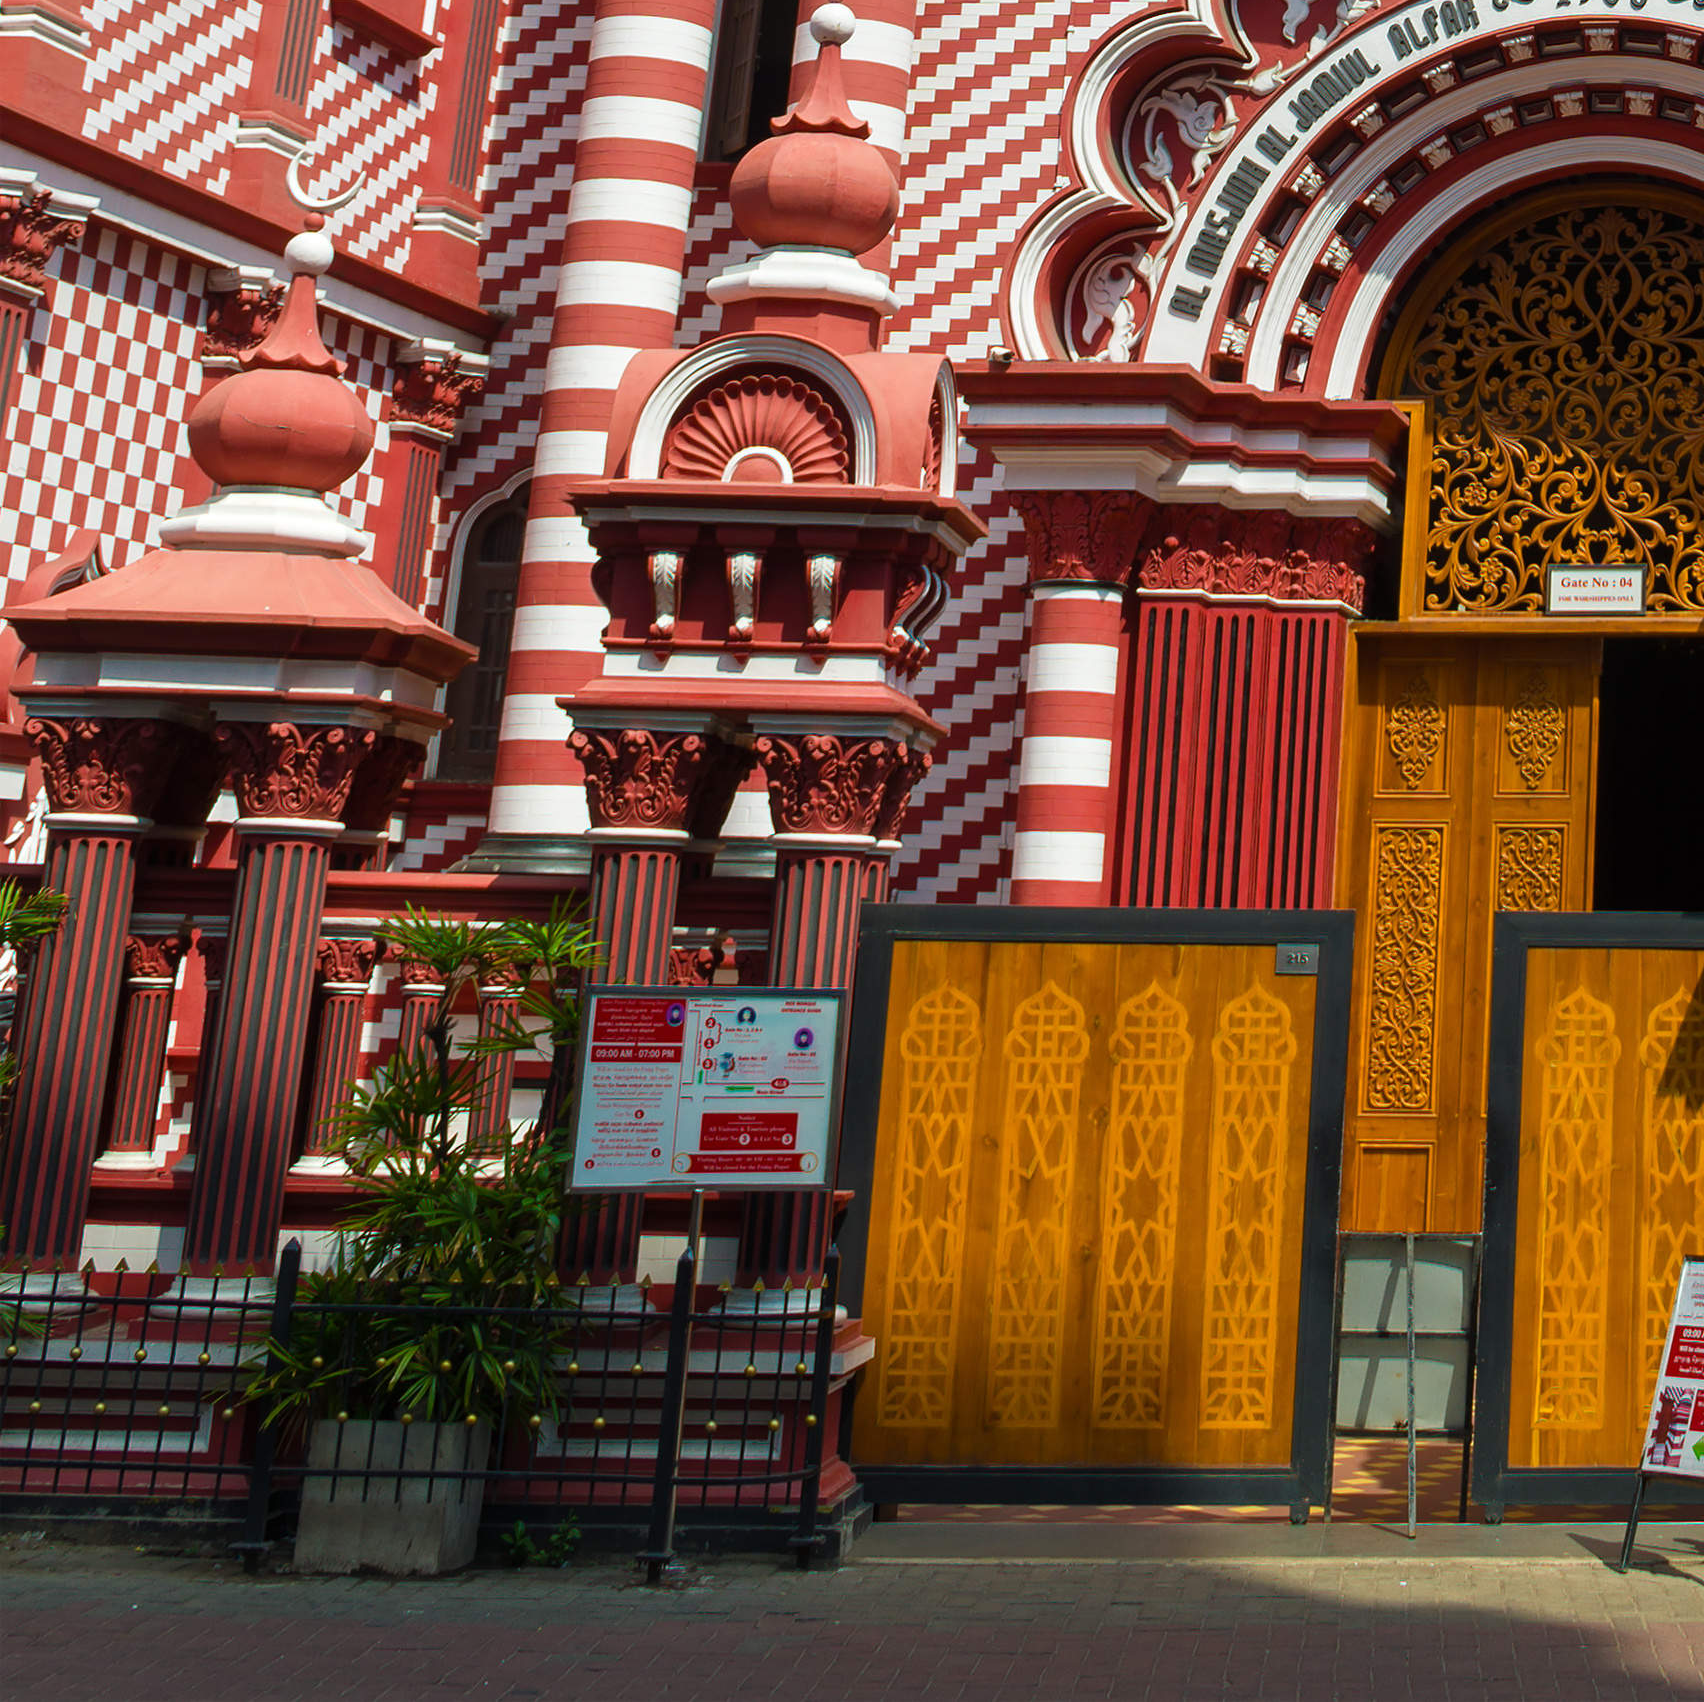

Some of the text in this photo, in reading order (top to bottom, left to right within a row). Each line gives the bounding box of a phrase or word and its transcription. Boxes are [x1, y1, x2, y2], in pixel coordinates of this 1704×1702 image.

[1295, 48, 1382, 134] JAMIUL
[1255, 123, 1298, 167] AL
[1185, 157, 1271, 280] MASJIDH
[1167, 284, 1211, 323] AL
[1561, 576, 1589, 588] Gate
[1592, 576, 1609, 588] No
[1619, 576, 1633, 588] 04
[1286, 951, 1310, 965] 215
[595, 1048, 619, 1058] 09:00
[619, 1048, 633, 1058] AM
[638, 1048, 660, 1058] 07:00
[661, 1048, 674, 1058] PM
[1682, 1328, 1702, 1338] 09:00
